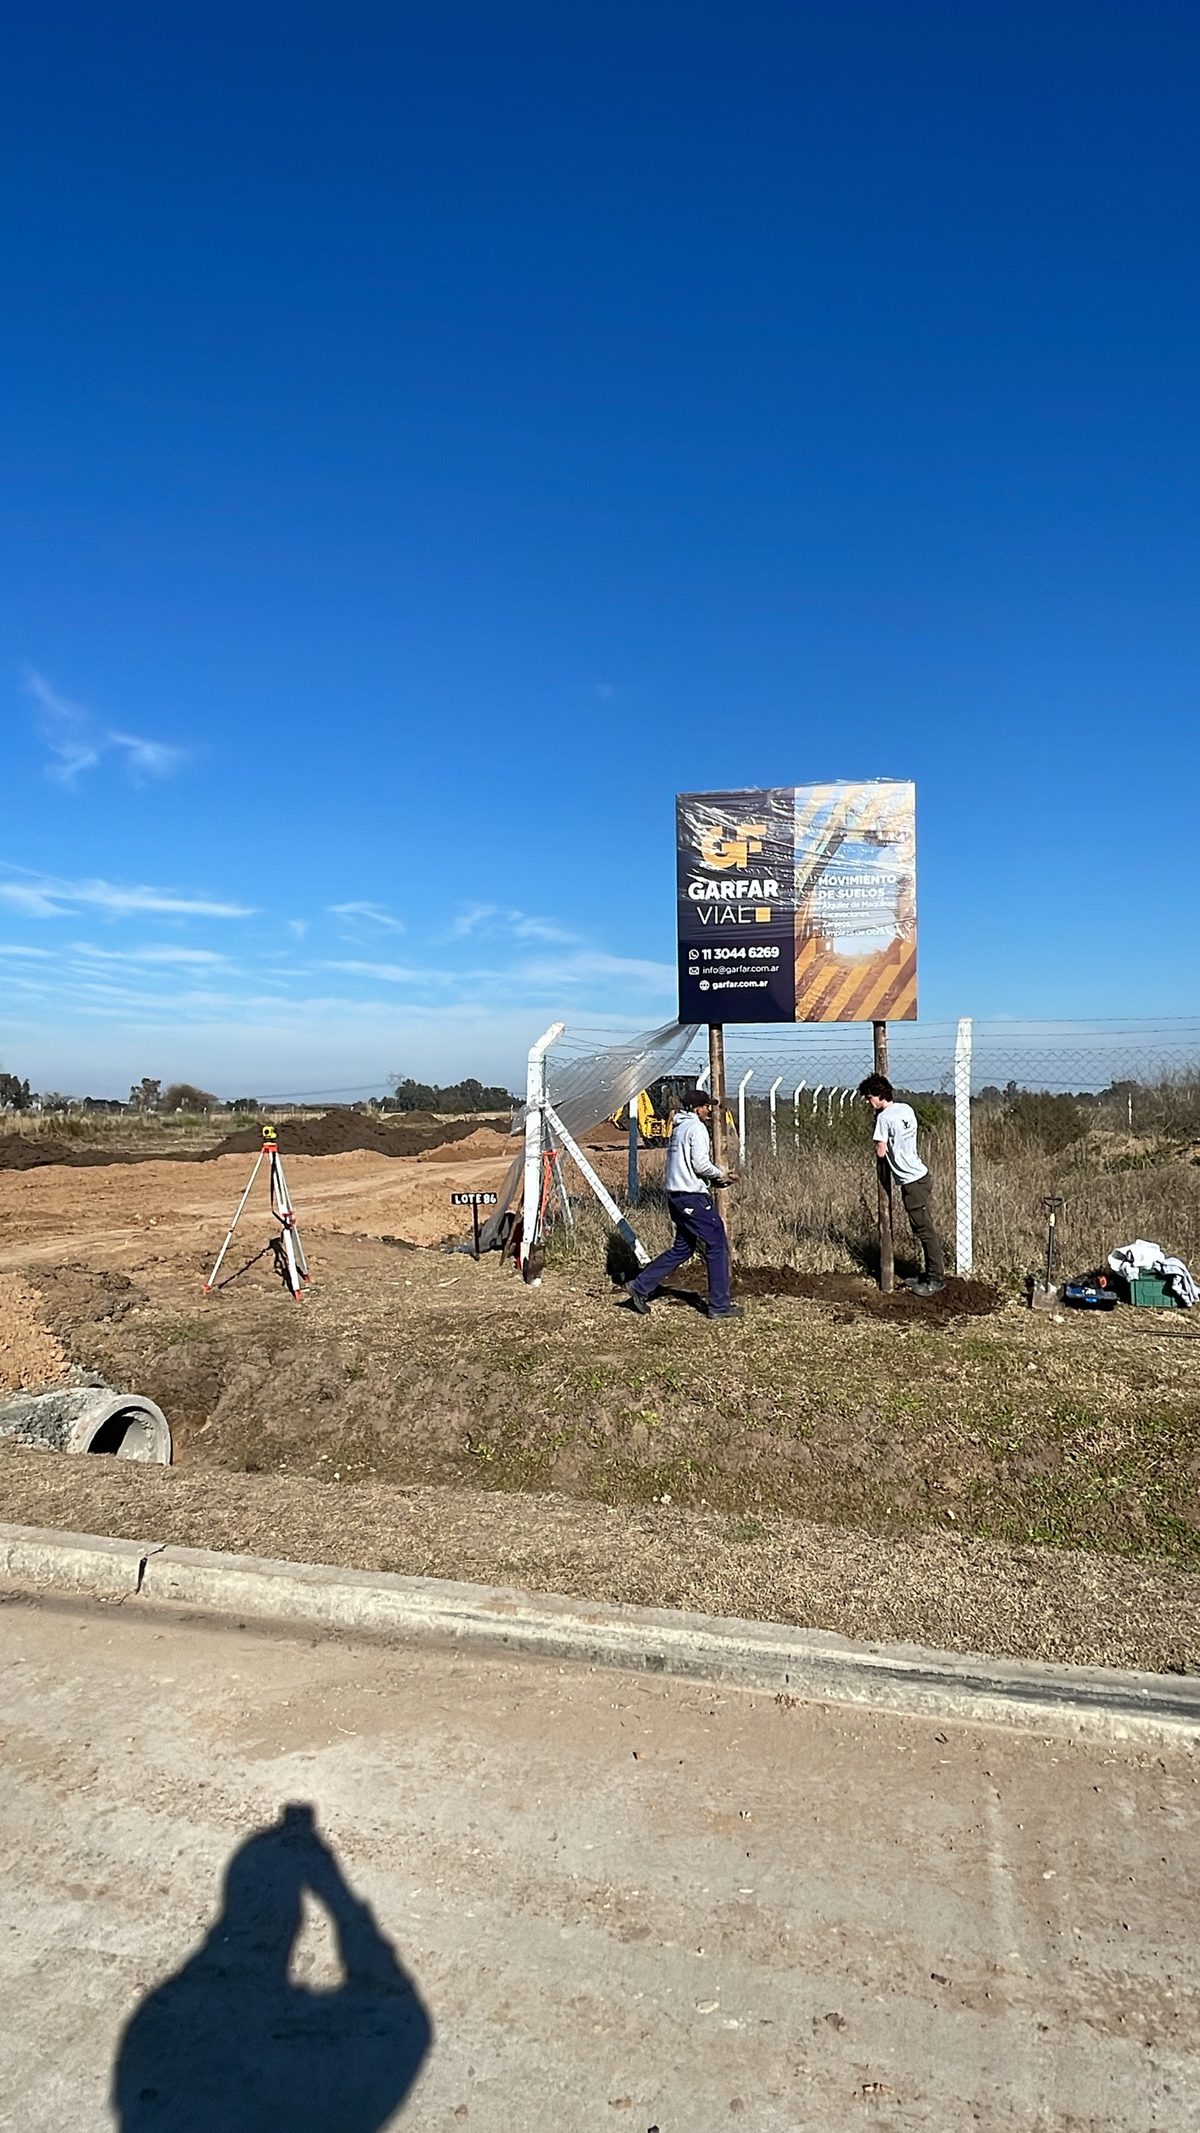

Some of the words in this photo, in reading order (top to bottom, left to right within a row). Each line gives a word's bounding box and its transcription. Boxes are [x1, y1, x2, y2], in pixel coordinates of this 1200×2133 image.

[818, 874, 897, 886] MOVIMIENTO
[688, 879, 779, 900] GARFAR
[819, 890, 835, 899] DE
[837, 887, 885, 898] SUELOS
[851, 900, 860, 908] de
[696, 905, 751, 925] VIAL
[701, 948, 712, 960] 11
[714, 947, 746, 960] 3044
[748, 946, 780, 958] 6269
[702, 964, 780, 975] info@garfar.com.ar
[712, 980, 768, 990] garfar.com.ar
[454, 1194, 482, 1204] LOTE
[483, 1193, 497, 1204] 86
